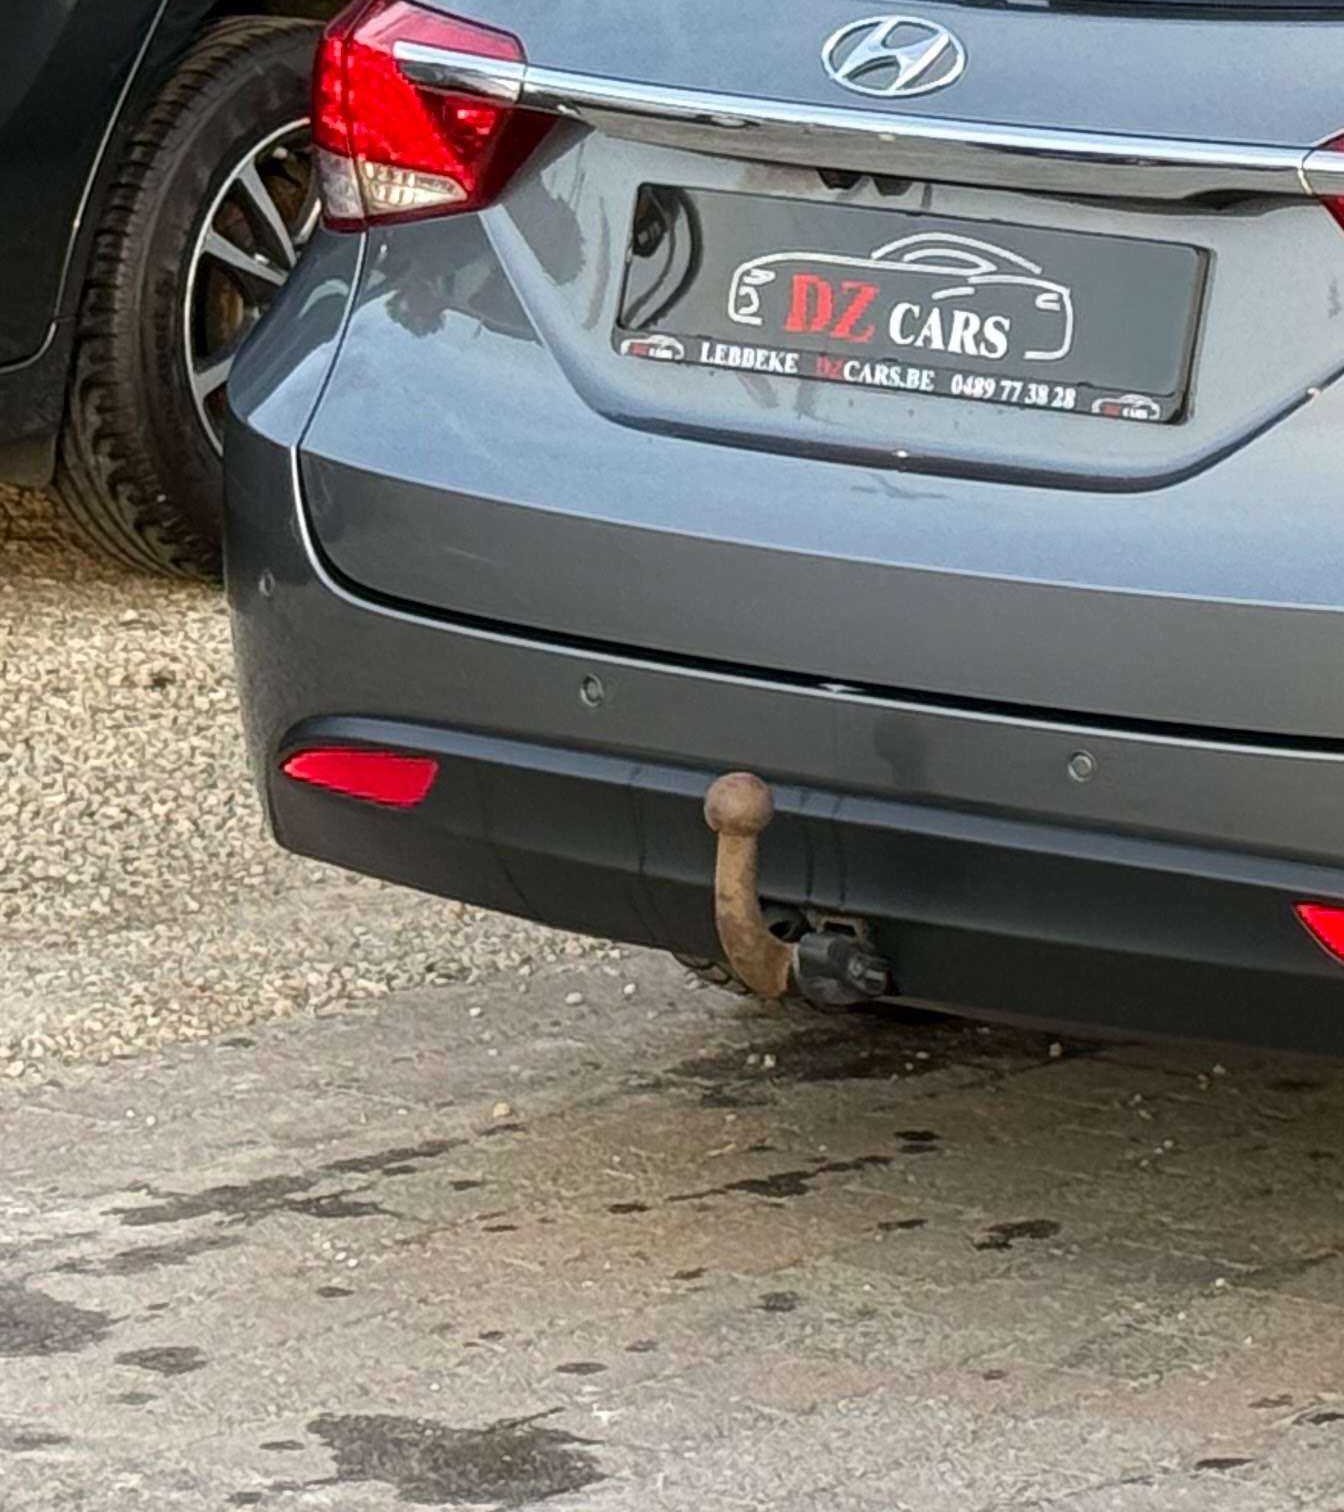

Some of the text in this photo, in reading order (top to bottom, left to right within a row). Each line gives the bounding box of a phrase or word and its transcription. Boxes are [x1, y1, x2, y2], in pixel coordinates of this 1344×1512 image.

[784, 272, 1011, 359] DZ CARS
[999, 379, 1024, 403] 77
[1051, 386, 1077, 410] 28
